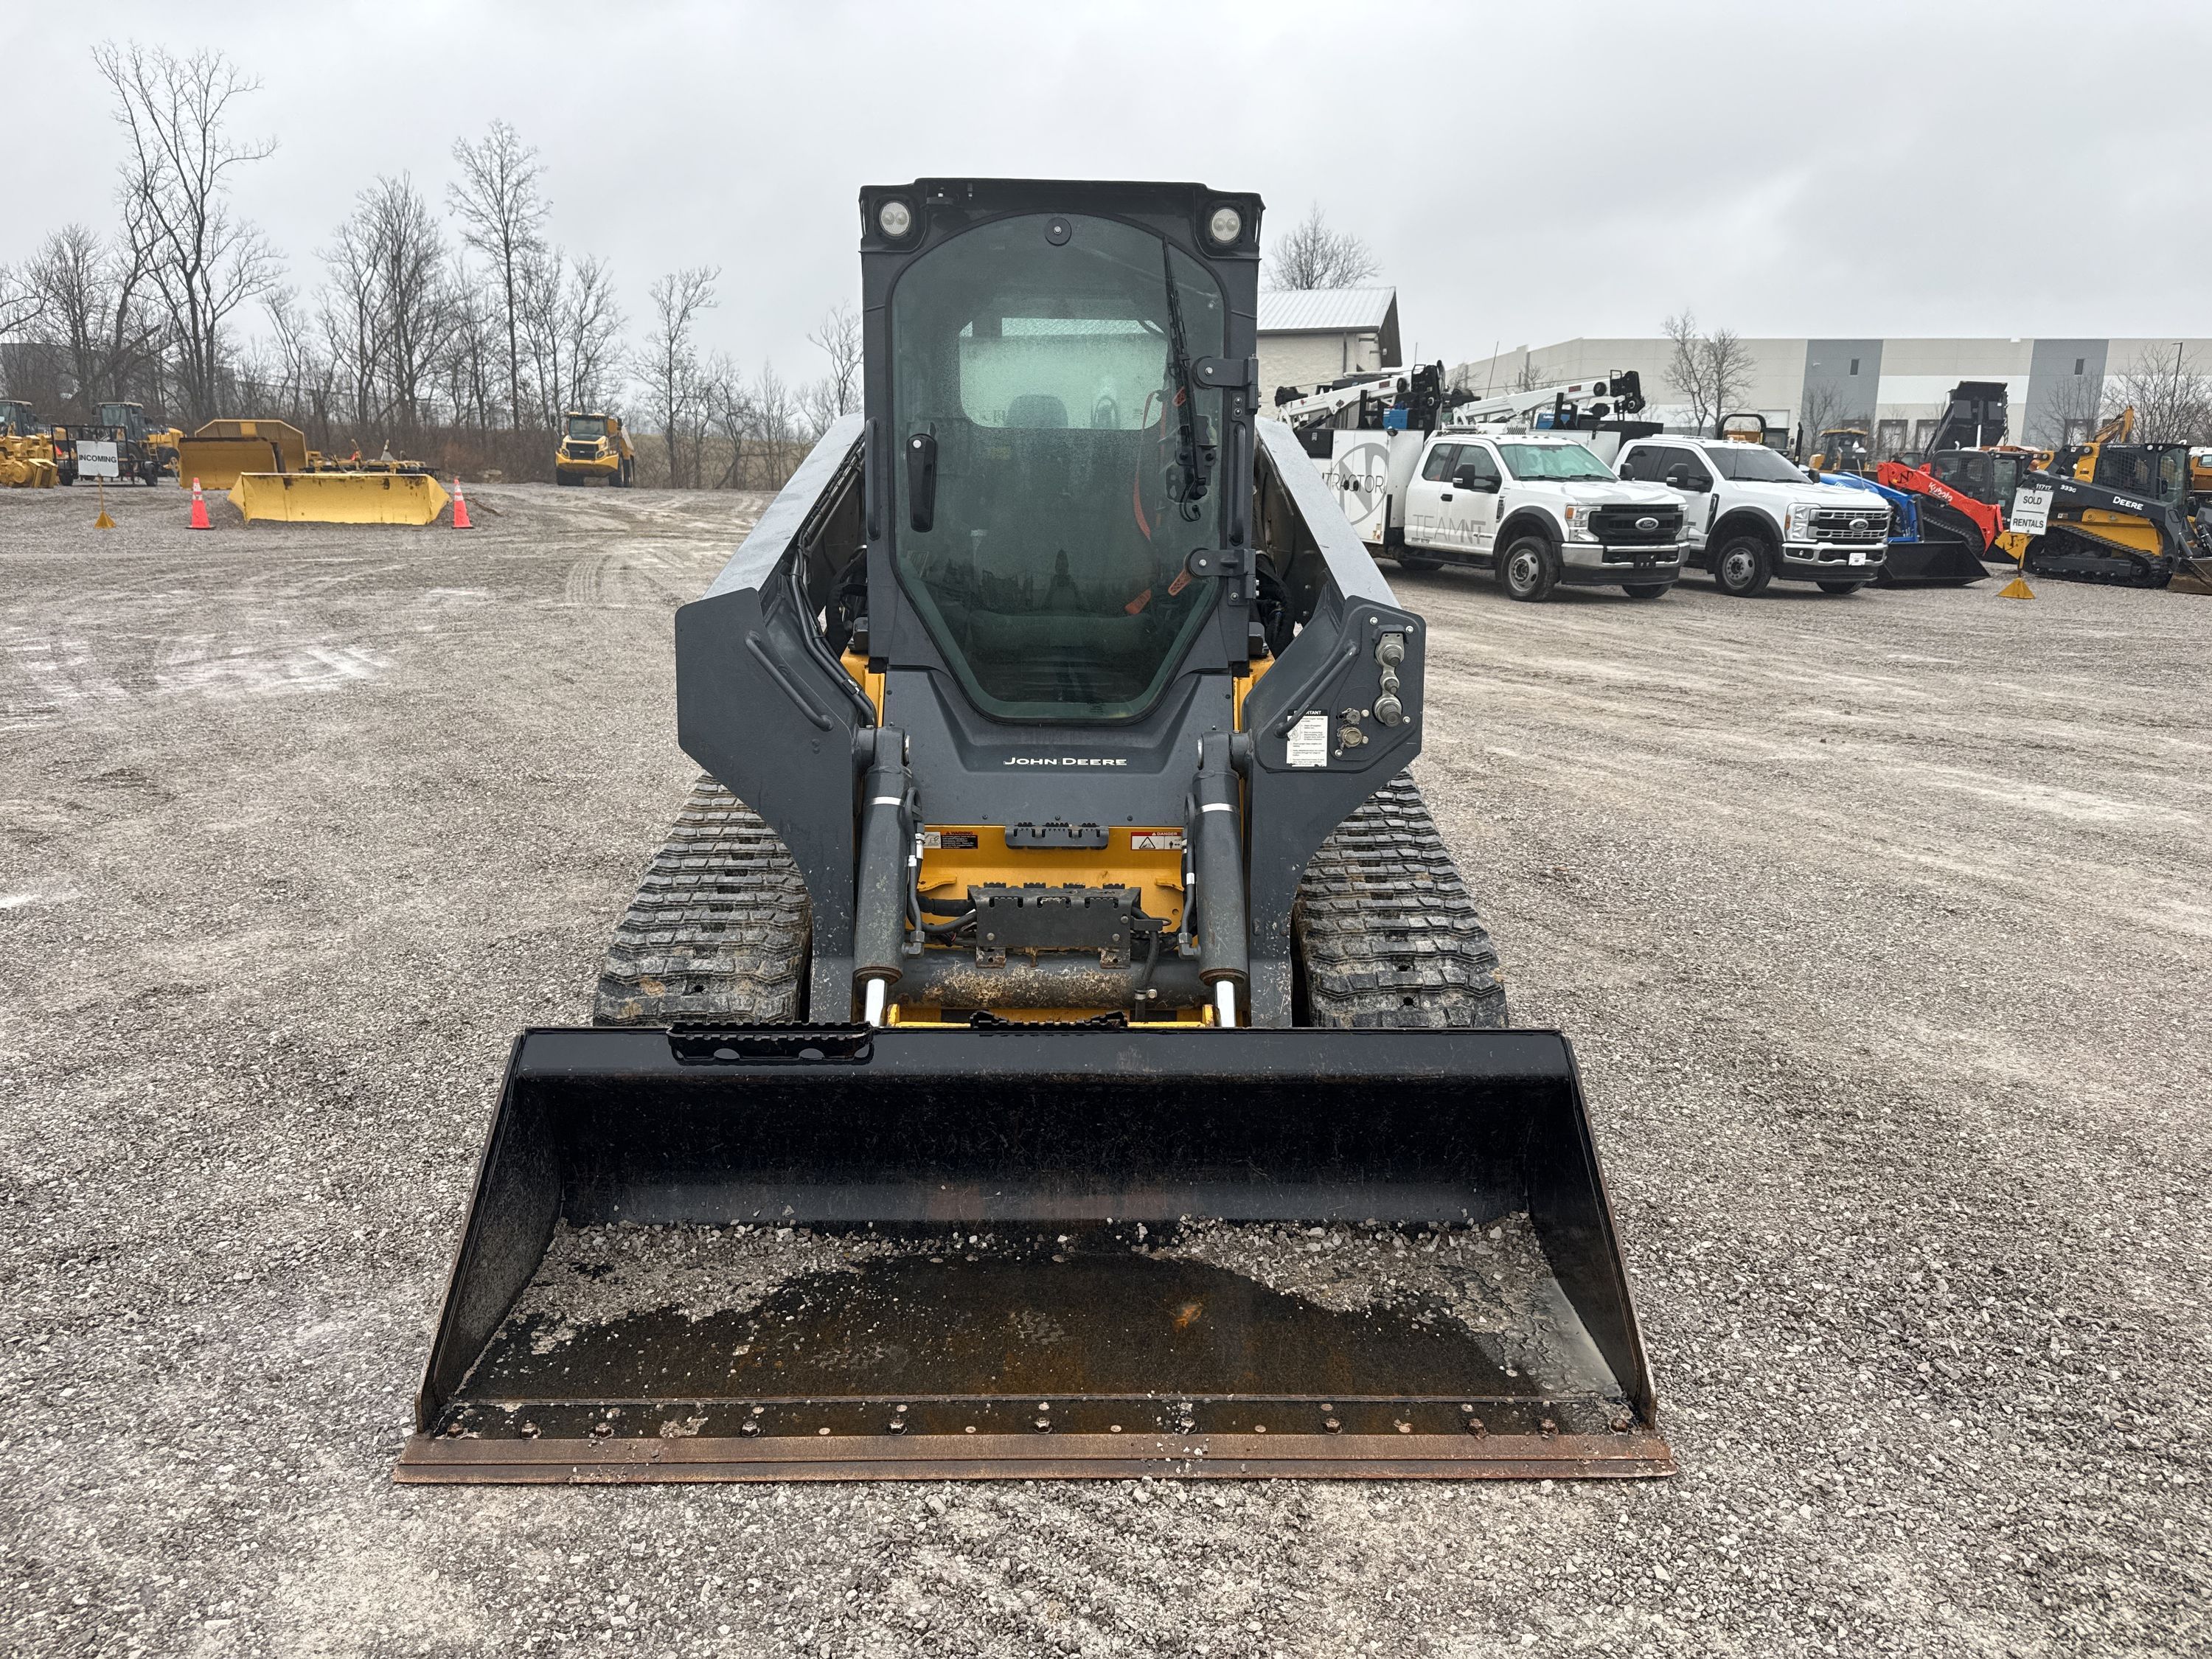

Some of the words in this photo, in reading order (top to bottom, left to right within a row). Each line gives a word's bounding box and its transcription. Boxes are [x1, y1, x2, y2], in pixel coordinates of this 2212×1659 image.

[79, 454, 116, 463] INCOMING
[1928, 481, 1953, 502] Kubota
[2060, 484, 2076, 493] 333G
[2023, 495, 2042, 505] SOLD
[2112, 496, 2143, 510] DEERE
[2012, 518, 2044, 528] RENTALS
[1004, 757, 1057, 765] JOHN
[1062, 757, 1127, 765] DEERE
